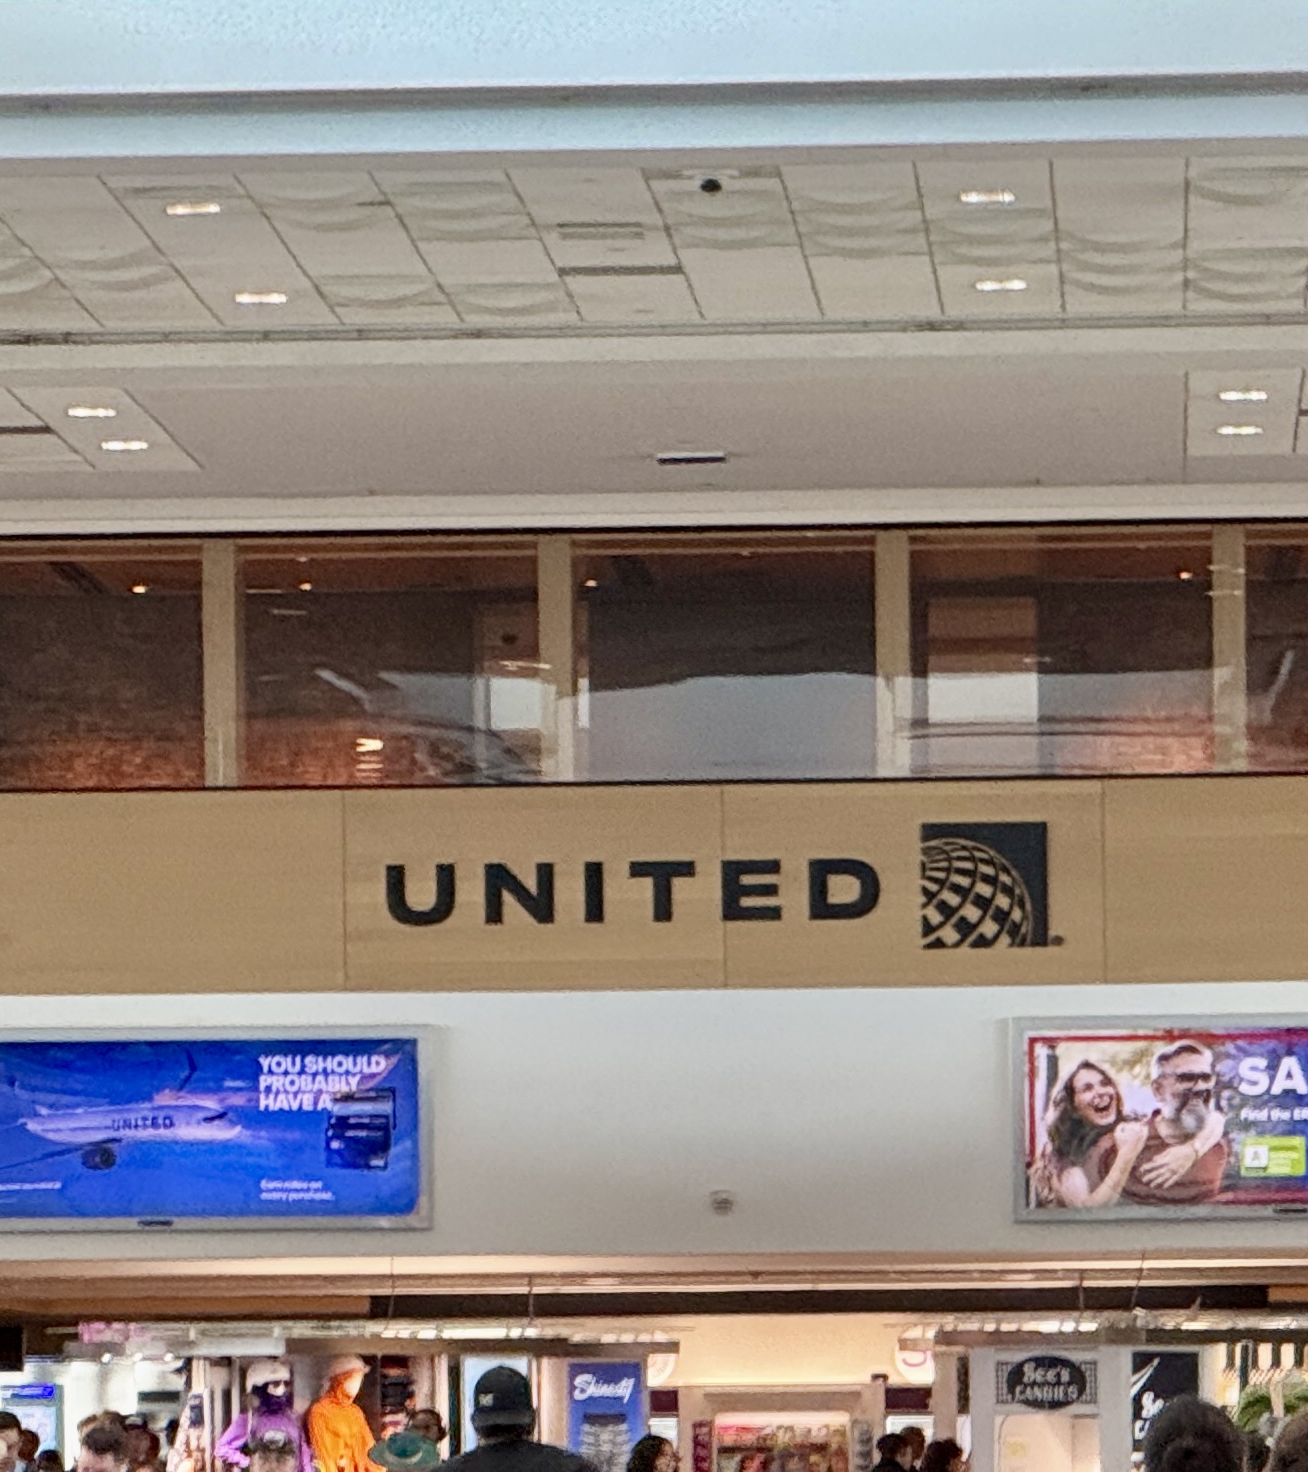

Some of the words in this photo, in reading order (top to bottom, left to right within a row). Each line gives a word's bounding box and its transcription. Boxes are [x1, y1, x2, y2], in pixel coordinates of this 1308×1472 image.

[386, 859, 881, 926] UNITED
[258, 1054, 301, 1073] YOU
[304, 1054, 387, 1073] SHOULD
[259, 1074, 361, 1092] PROBABLY
[259, 1093, 314, 1111] HAVE
[316, 1094, 333, 1111] A
[1270, 1107, 1291, 1121] the
[112, 1116, 176, 1131] UNITED
[1022, 1360, 1070, 1384] See's
